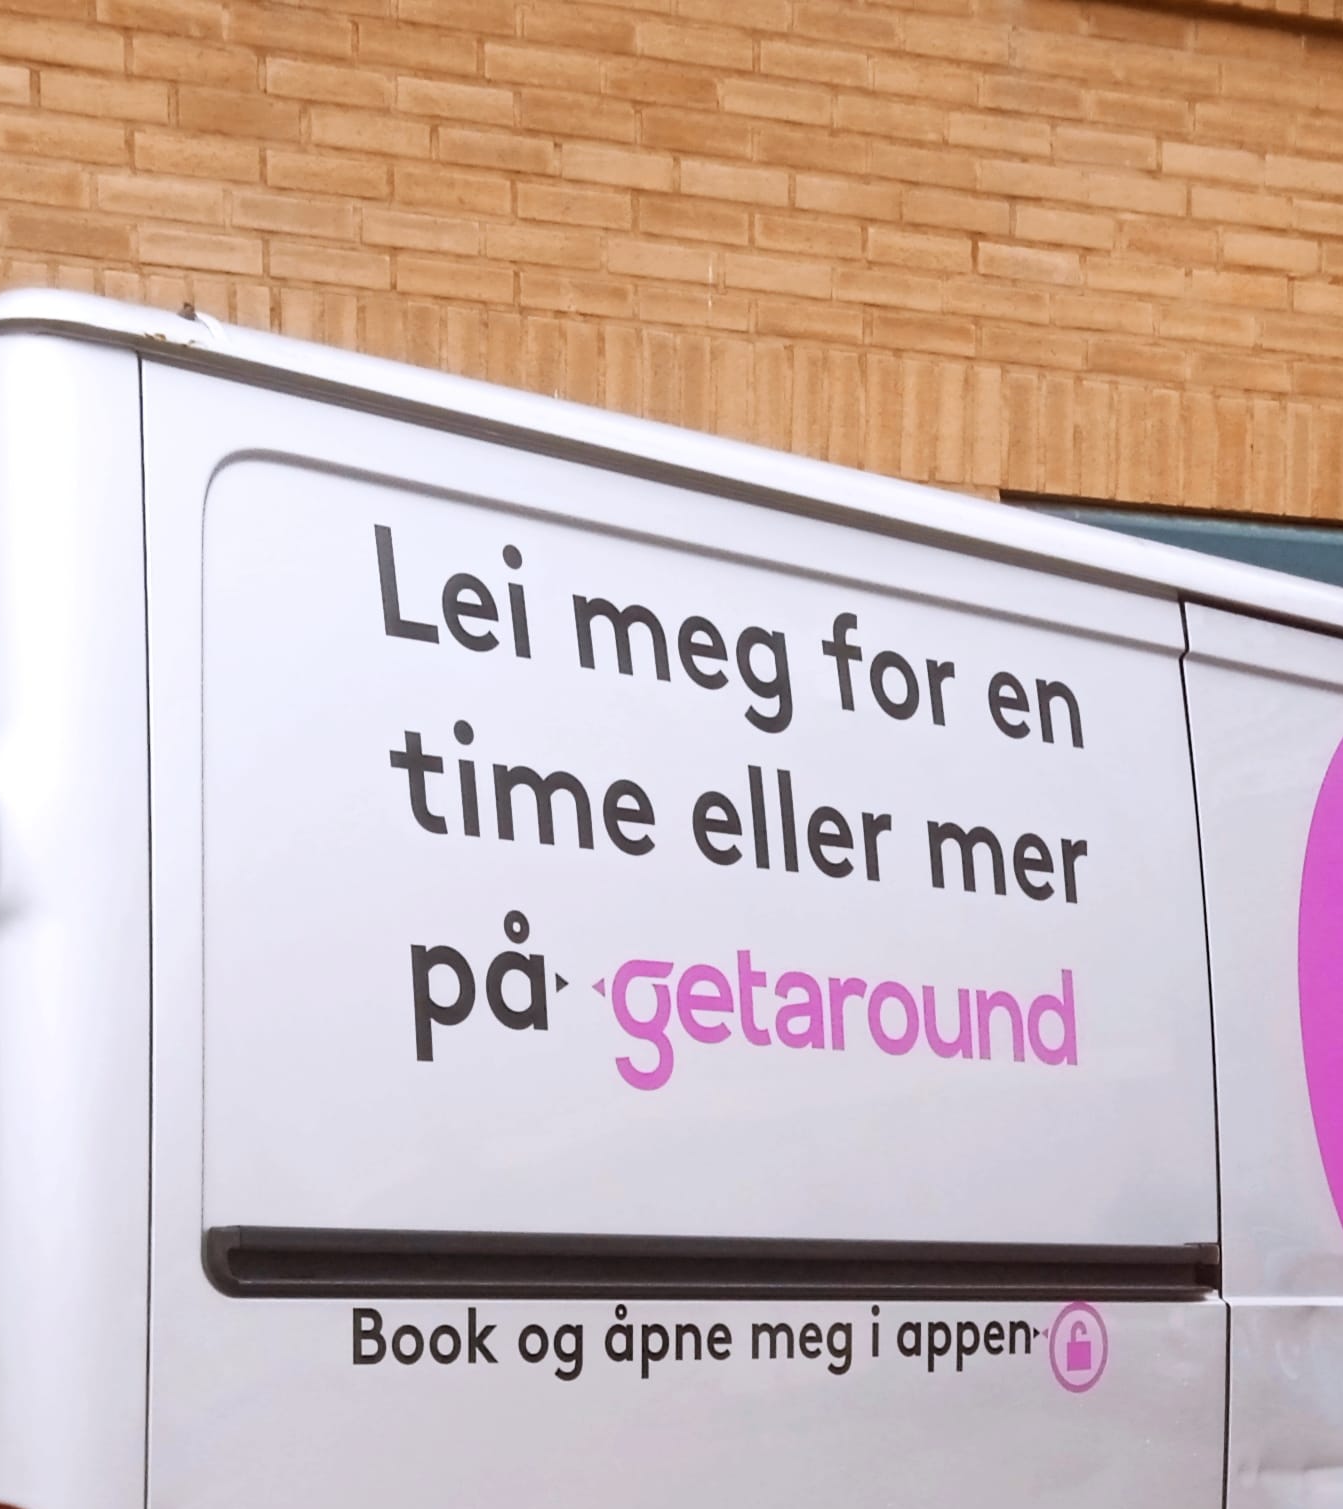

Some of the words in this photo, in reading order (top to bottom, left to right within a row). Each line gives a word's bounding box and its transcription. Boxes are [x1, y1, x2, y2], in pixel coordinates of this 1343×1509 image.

[373, 524, 532, 659] Lei
[571, 593, 794, 735] meg
[820, 612, 956, 727] for
[987, 670, 1085, 749] en
[389, 719, 657, 857] time
[691, 764, 893, 883] eller
[927, 820, 1089, 904] mer
[410, 909, 550, 1063] på
[611, 948, 1079, 1092] getaround
[351, 1306, 499, 1366] Book
[517, 1322, 585, 1382] og
[604, 1303, 734, 1380] åpne
[750, 1321, 854, 1377] meg
[870, 1304, 882, 1358] i
[895, 1319, 1033, 1373] appen
